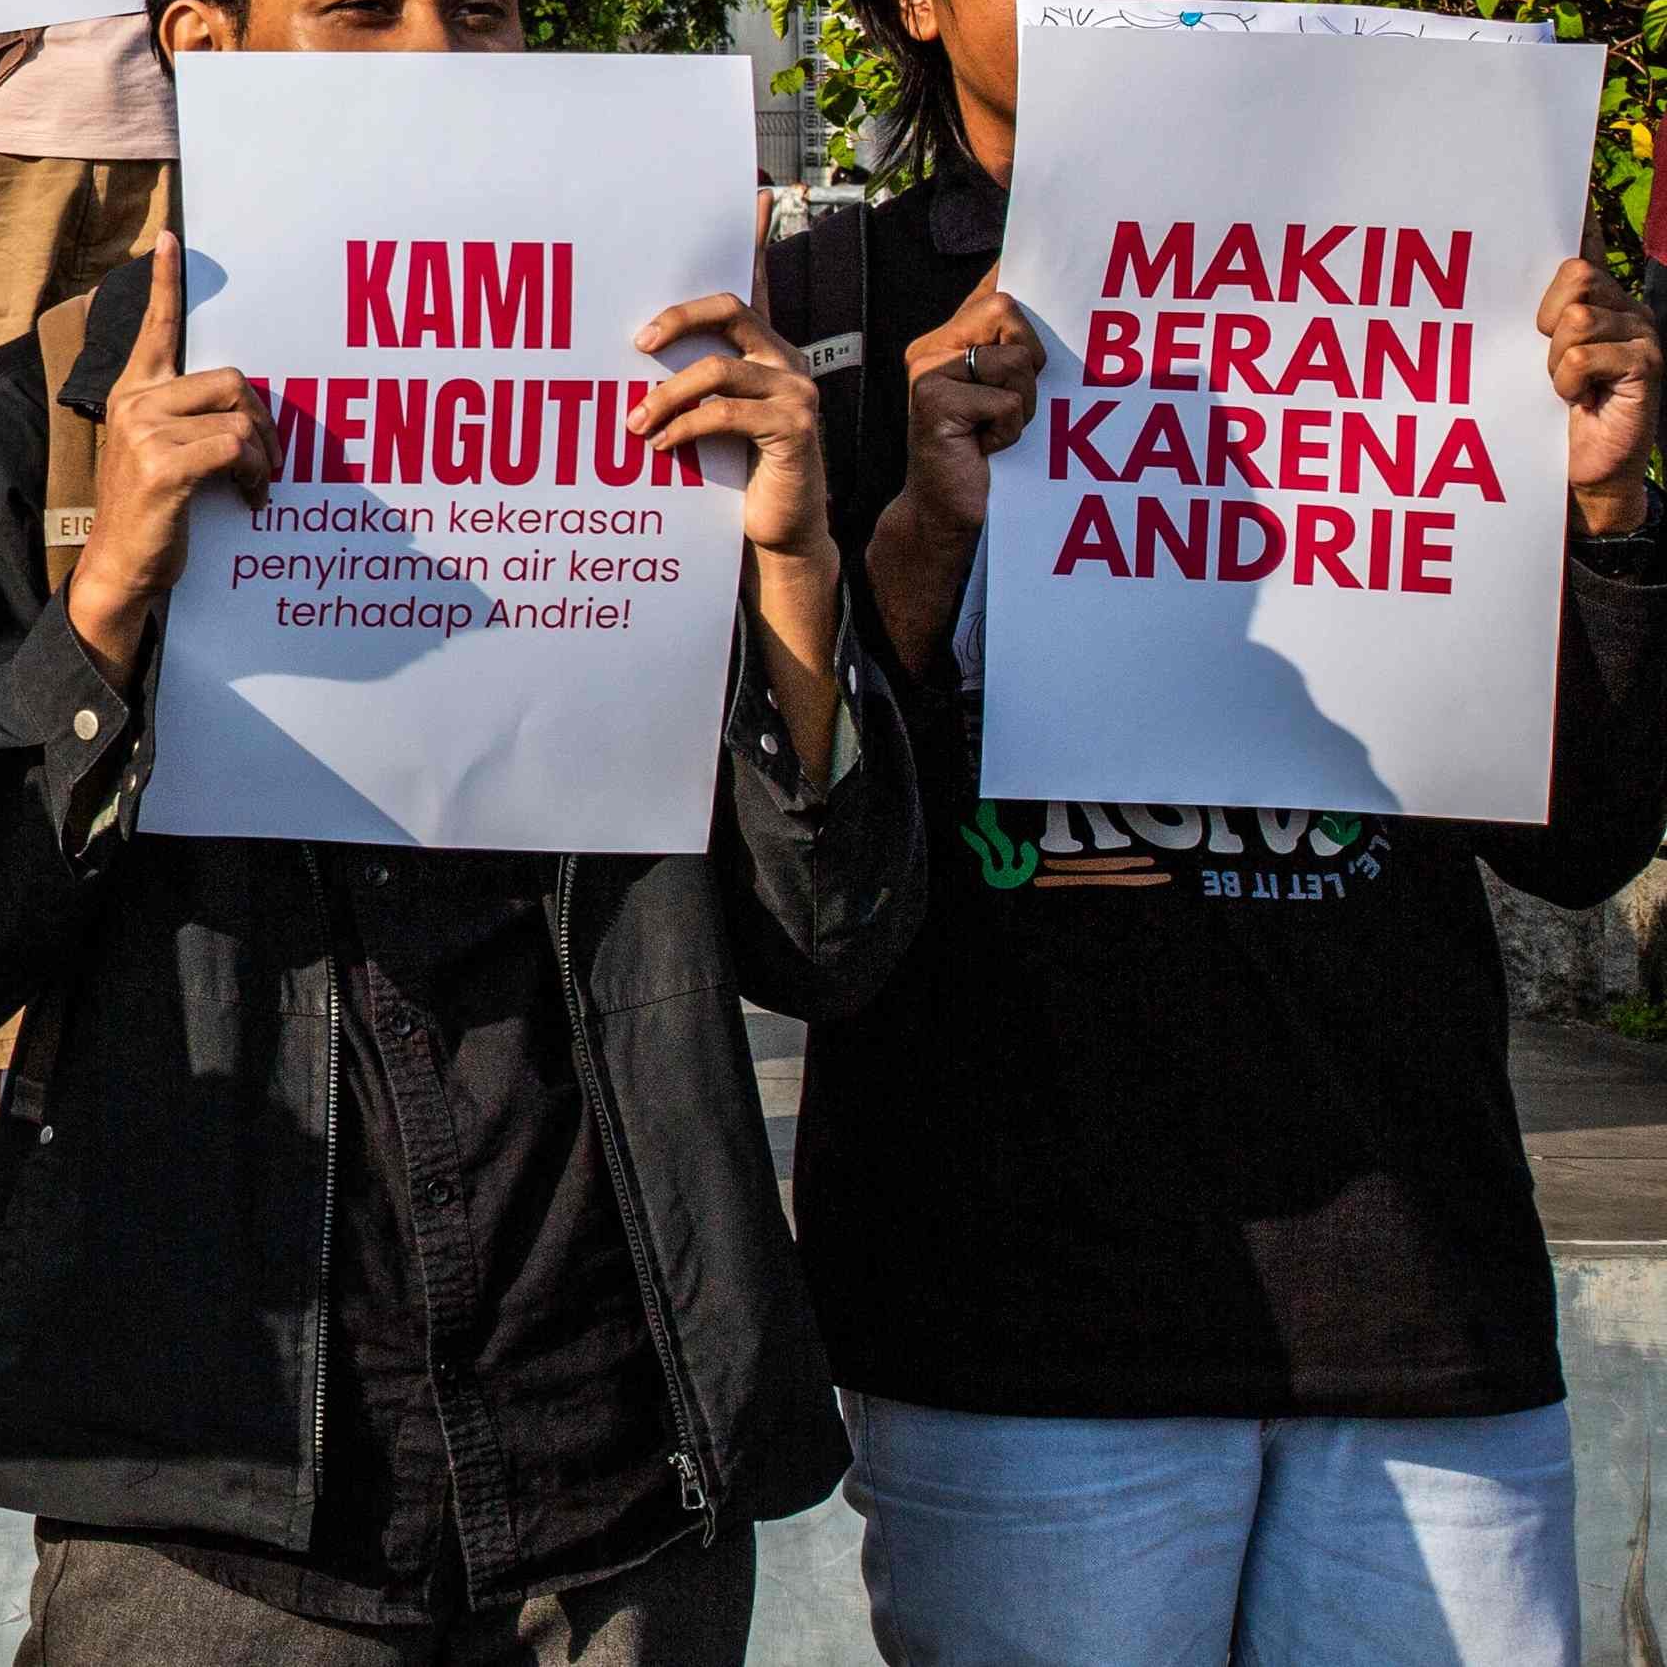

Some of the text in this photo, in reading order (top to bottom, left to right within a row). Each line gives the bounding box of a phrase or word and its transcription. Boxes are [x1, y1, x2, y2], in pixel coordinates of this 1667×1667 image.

[346, 240, 572, 349] KAMI
[1102, 221, 1472, 309] MAKIN
[1083, 310, 1472, 404] BERANI
[1048, 399, 1506, 502] KARENA
[250, 500, 663, 534] tindakan kekerasan
[1053, 495, 1456, 595] ANDRIE
[232, 548, 680, 589] penyiraman air keras
[276, 596, 631, 638] terhadap Andrie!
[1202, 870, 1346, 900] LET IT BE
